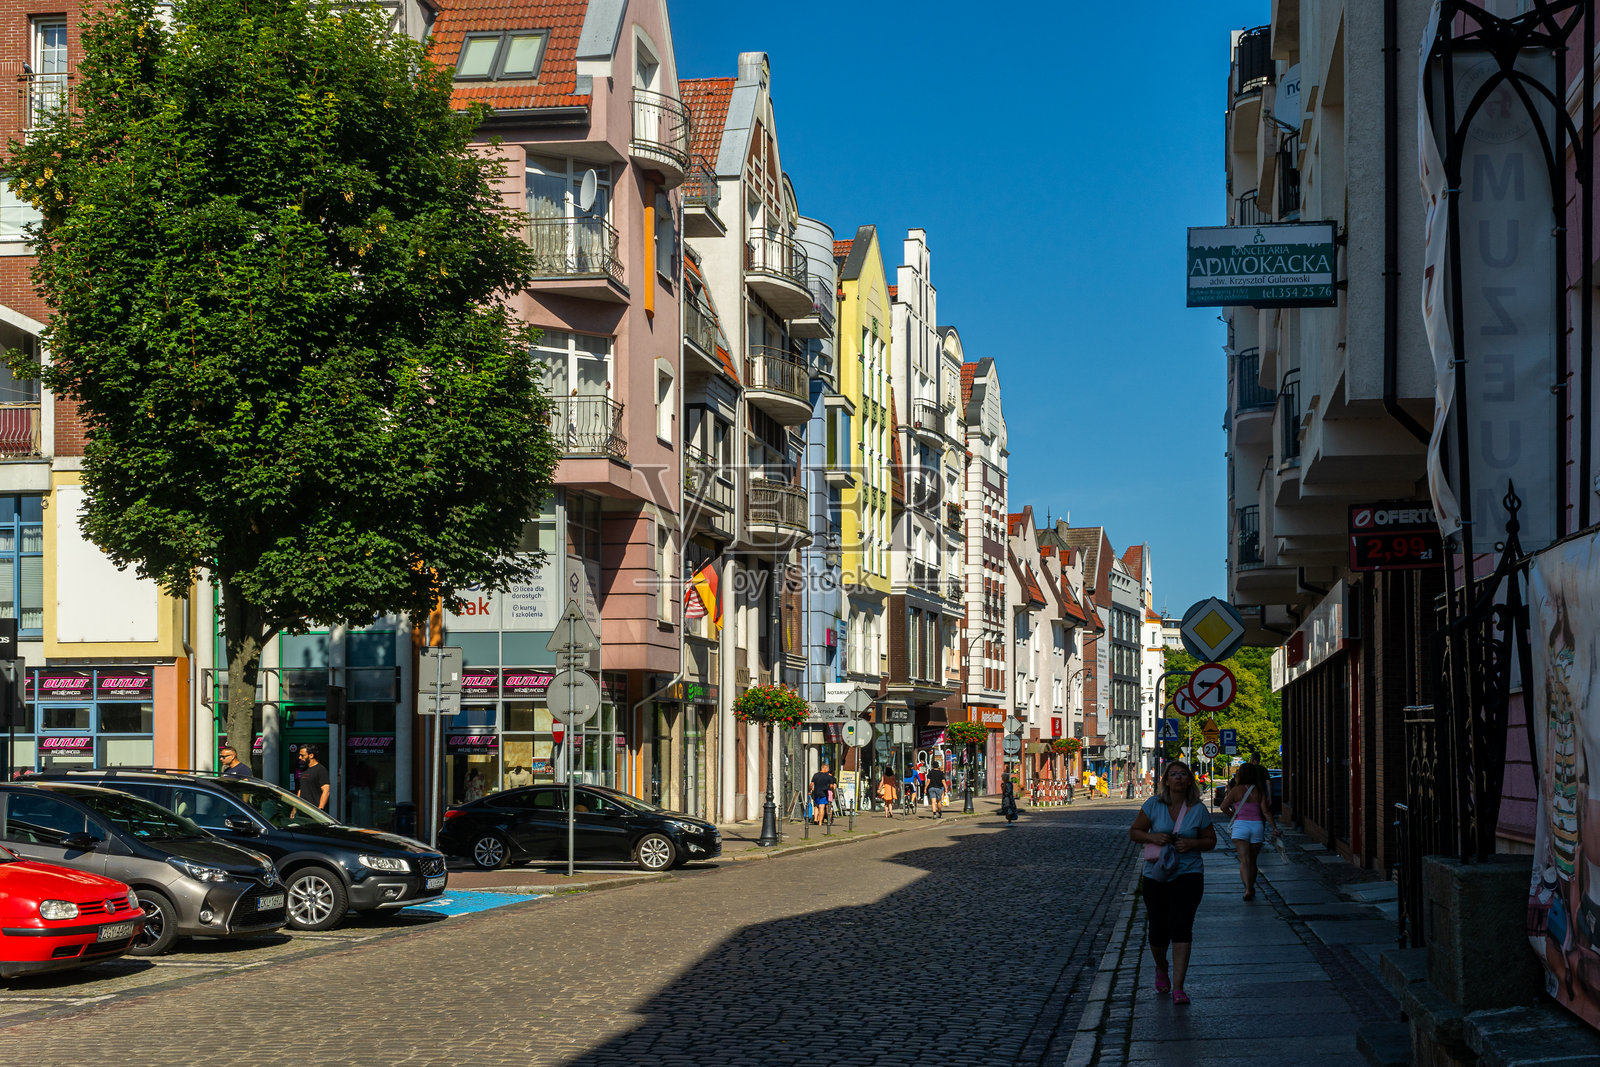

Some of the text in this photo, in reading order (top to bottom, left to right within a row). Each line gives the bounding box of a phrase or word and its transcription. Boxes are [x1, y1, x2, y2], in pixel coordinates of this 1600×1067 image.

[1231, 246, 1290, 256] KANCELARIA
[1190, 254, 1330, 276] ADWOKACKA
[1230, 275, 1267, 288] Krzysztof
[1268, 274, 1310, 285] Gularowski
[1302, 287, 1315, 297] 25
[1319, 286, 1332, 296] 76
[520, 604, 537, 612] kursy
[43, 679, 89, 688] OUTLET
[102, 678, 148, 688] OUTLET
[461, 676, 498, 686] UTLET
[506, 676, 553, 686] OUTLET
[43, 738, 90, 747] OUTLET
[347, 737, 394, 746] OUTLET
[449, 736, 497, 745] OUTLET
[1223, 731, 1233, 744] P
[1205, 745, 1217, 755] 20
